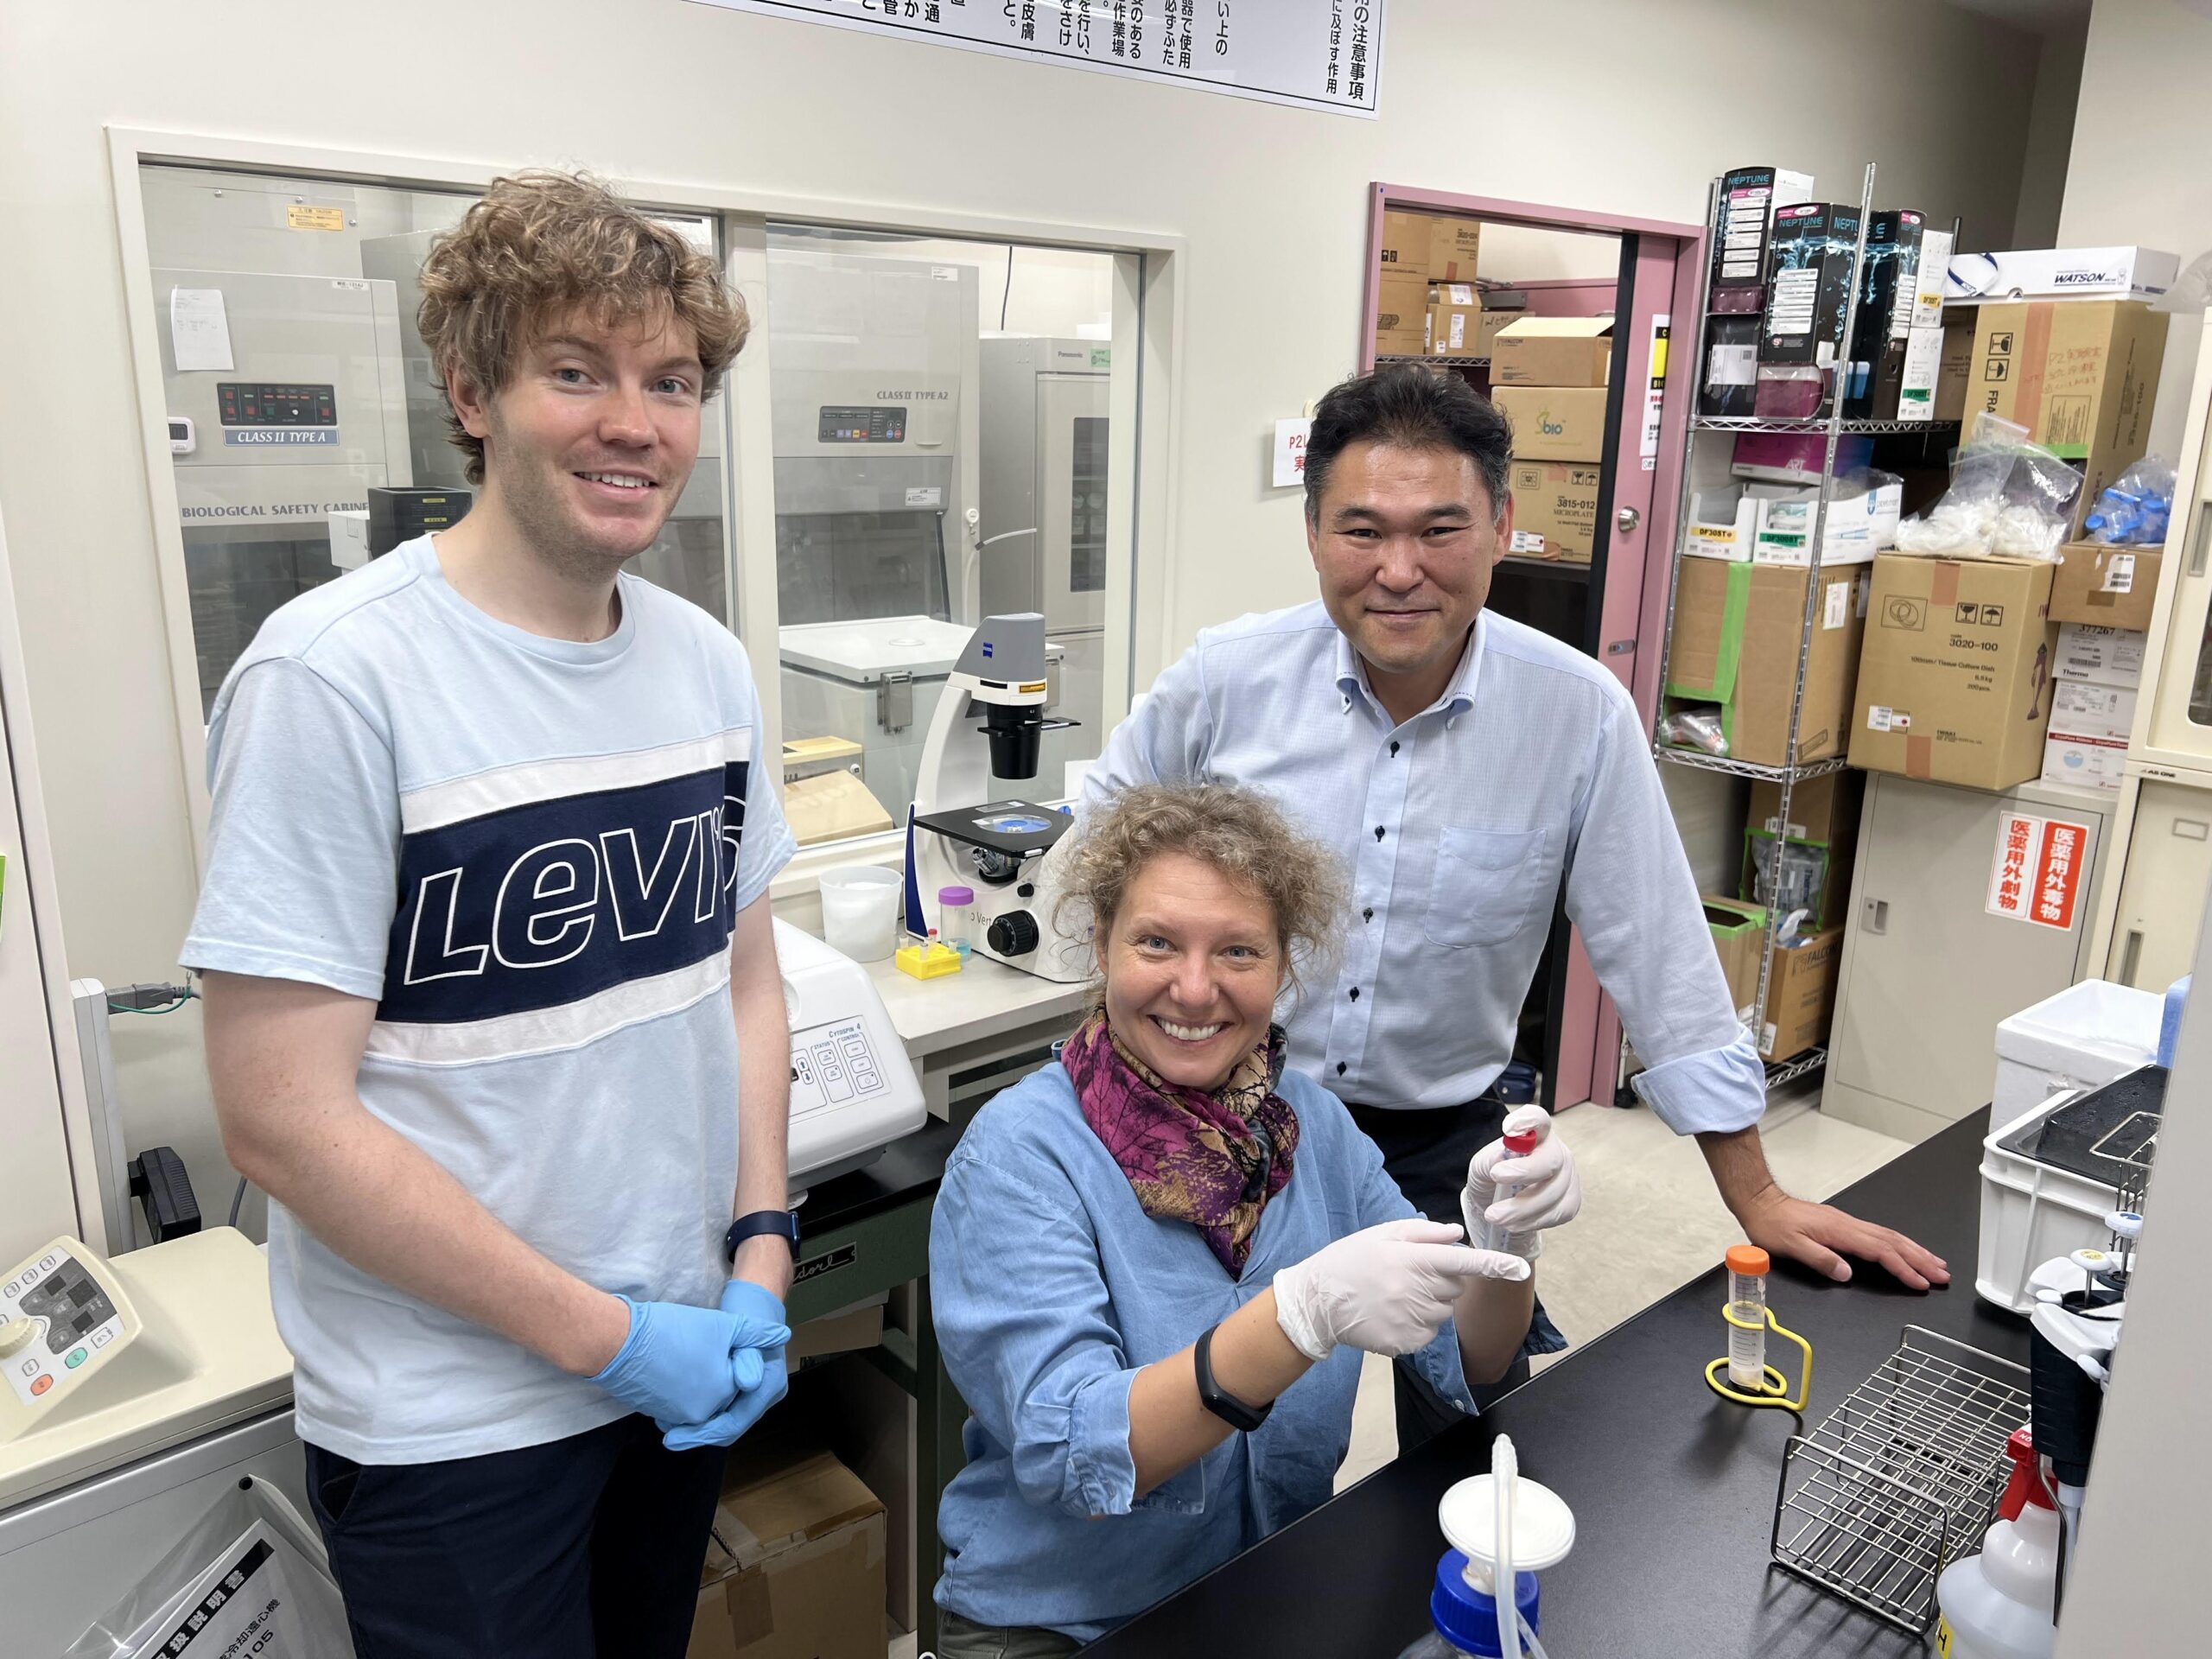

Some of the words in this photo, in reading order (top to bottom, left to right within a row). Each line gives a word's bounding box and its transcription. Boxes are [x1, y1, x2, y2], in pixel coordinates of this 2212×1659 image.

[1179, 0, 1194, 69] 器で使用
[1728, 175, 1770, 185] NEPTUNE
[1779, 217, 1823, 227] NEPTUNE
[2055, 272, 2106, 284] WATSON
[876, 391, 904, 400] CLASS
[915, 391, 937, 400] TYPE
[238, 432, 273, 442] CLASS
[289, 432, 315, 442] TYPE
[317, 433, 327, 442] A
[1557, 499, 1596, 510] 3815-012
[181, 505, 268, 518] BIOLOGICAL
[271, 505, 319, 516] SAFETY
[1949, 639, 1999, 652] 3020-100
[1999, 819, 2031, 911] 医薬用外劇物
[2040, 827, 2076, 921] 医薬用外毒物
